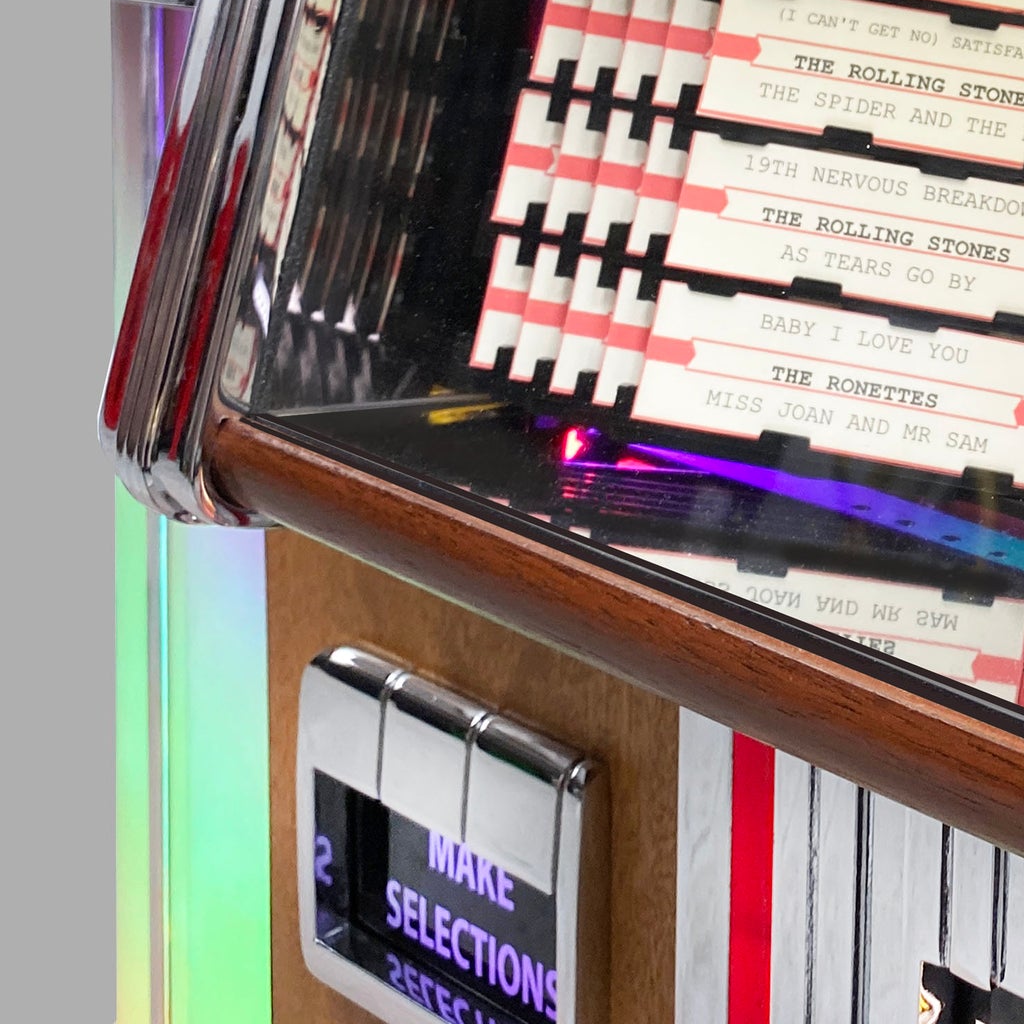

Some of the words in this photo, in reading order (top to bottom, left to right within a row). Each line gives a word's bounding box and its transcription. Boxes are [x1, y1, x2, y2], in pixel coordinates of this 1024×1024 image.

[778, 9, 796, 23] (I
[807, 11, 860, 32] CAN'T
[868, 21, 901, 39] GET
[910, 29, 939, 47] NO)
[794, 54, 834, 75] THE
[848, 64, 945, 94] ROLLING
[759, 82, 799, 104] THE
[814, 91, 896, 121] SPIDER
[909, 107, 953, 129] AND
[966, 117, 1007, 139] THE
[744, 153, 799, 179] 19TH
[812, 166, 909, 197] NERVOUS
[762, 206, 802, 229] THE
[816, 216, 914, 247] ROLLING
[927, 235, 1011, 263] STONES
[780, 245, 810, 263] AS
[824, 251, 892, 279] TEARS
[905, 266, 935, 285] GO
[948, 273, 977, 292] BY
[760, 313, 816, 339] BABY
[831, 325, 842, 342] I
[858, 329, 913, 355] LOVE
[927, 341, 969, 365] YOU
[771, 365, 812, 387] THE
[826, 375, 939, 409] RONETTES
[705, 389, 762, 414] MISS
[778, 401, 834, 426] JOAN
[847, 413, 890, 435] AND
[903, 422, 932, 443] MR
[945, 431, 990, 454] SAM
[428, 830, 515, 912] MAKE
[385, 879, 557, 1019] SELECTIONS
